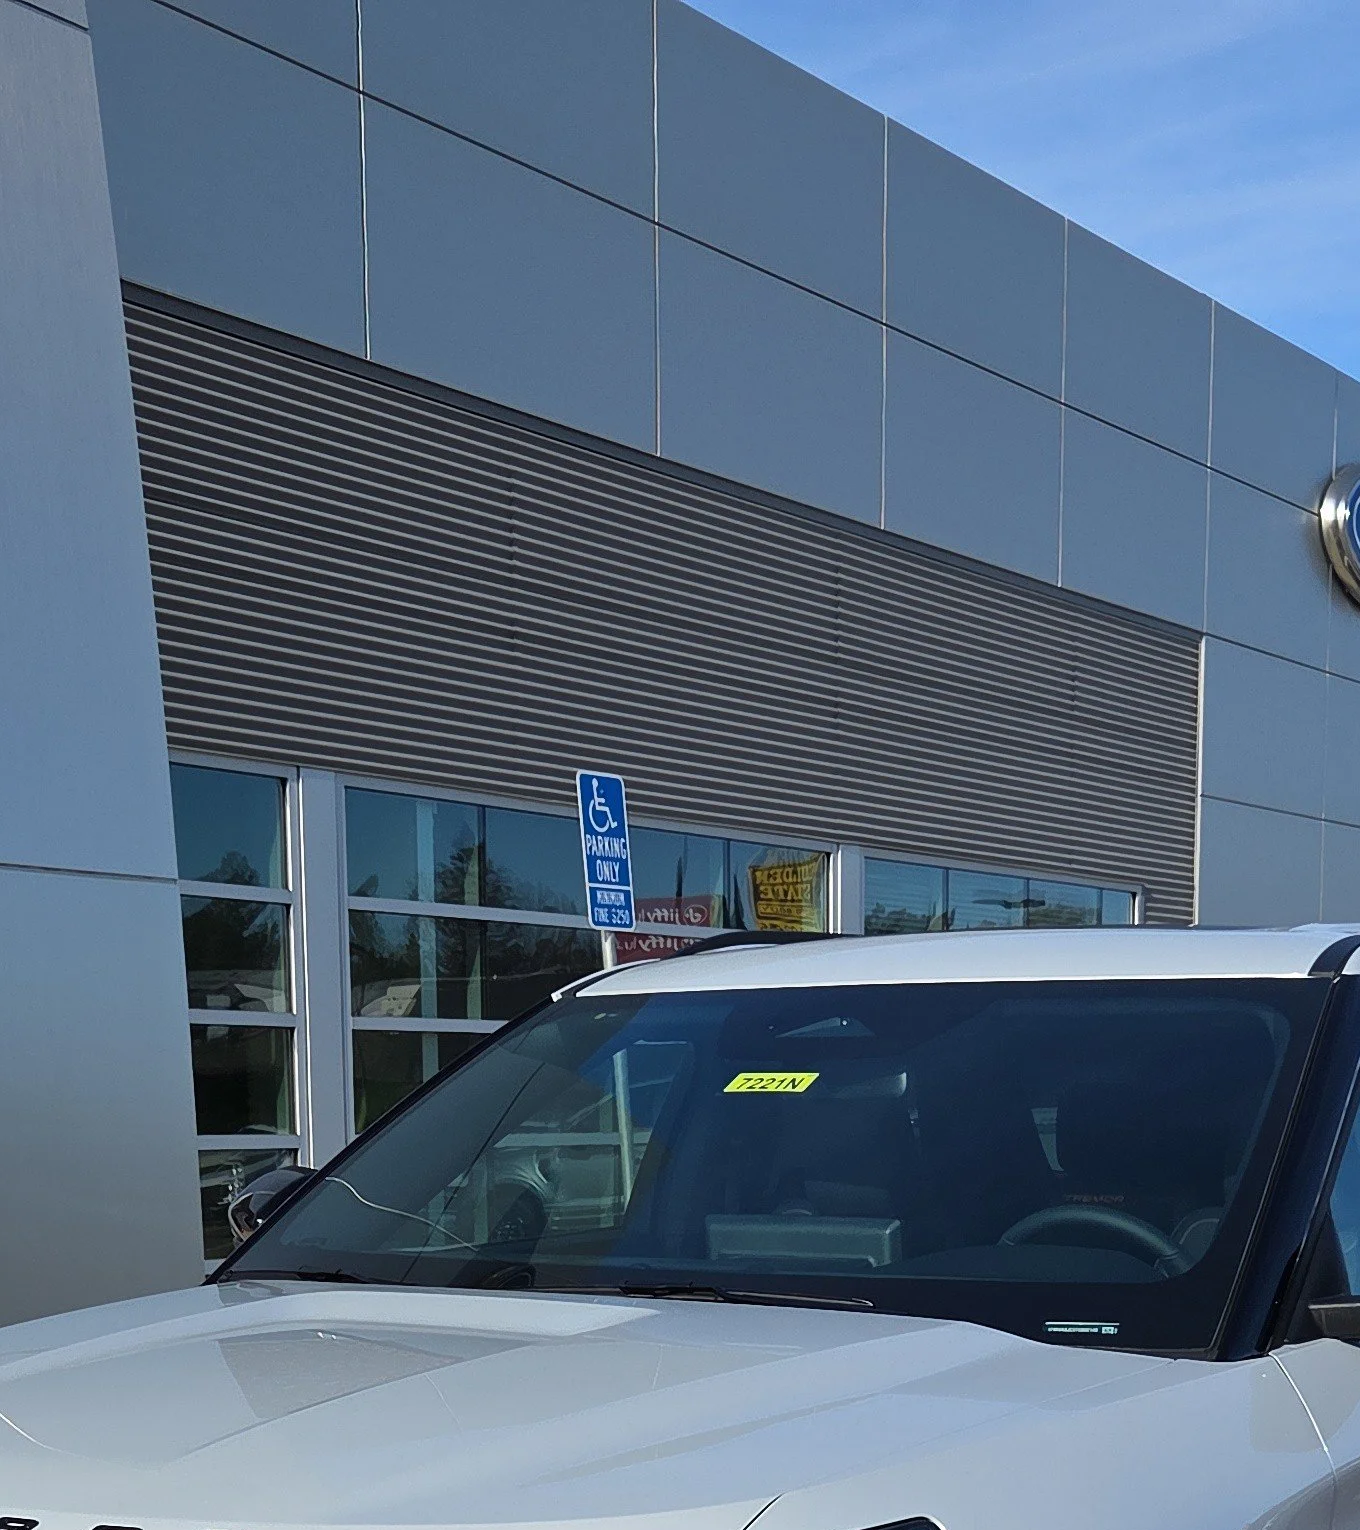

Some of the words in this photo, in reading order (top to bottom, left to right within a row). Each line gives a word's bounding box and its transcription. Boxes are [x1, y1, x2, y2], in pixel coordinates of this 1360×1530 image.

[585, 834, 627, 859] PARKING
[596, 859, 620, 883] ONLY
[736, 1077, 806, 1090] 7221N
